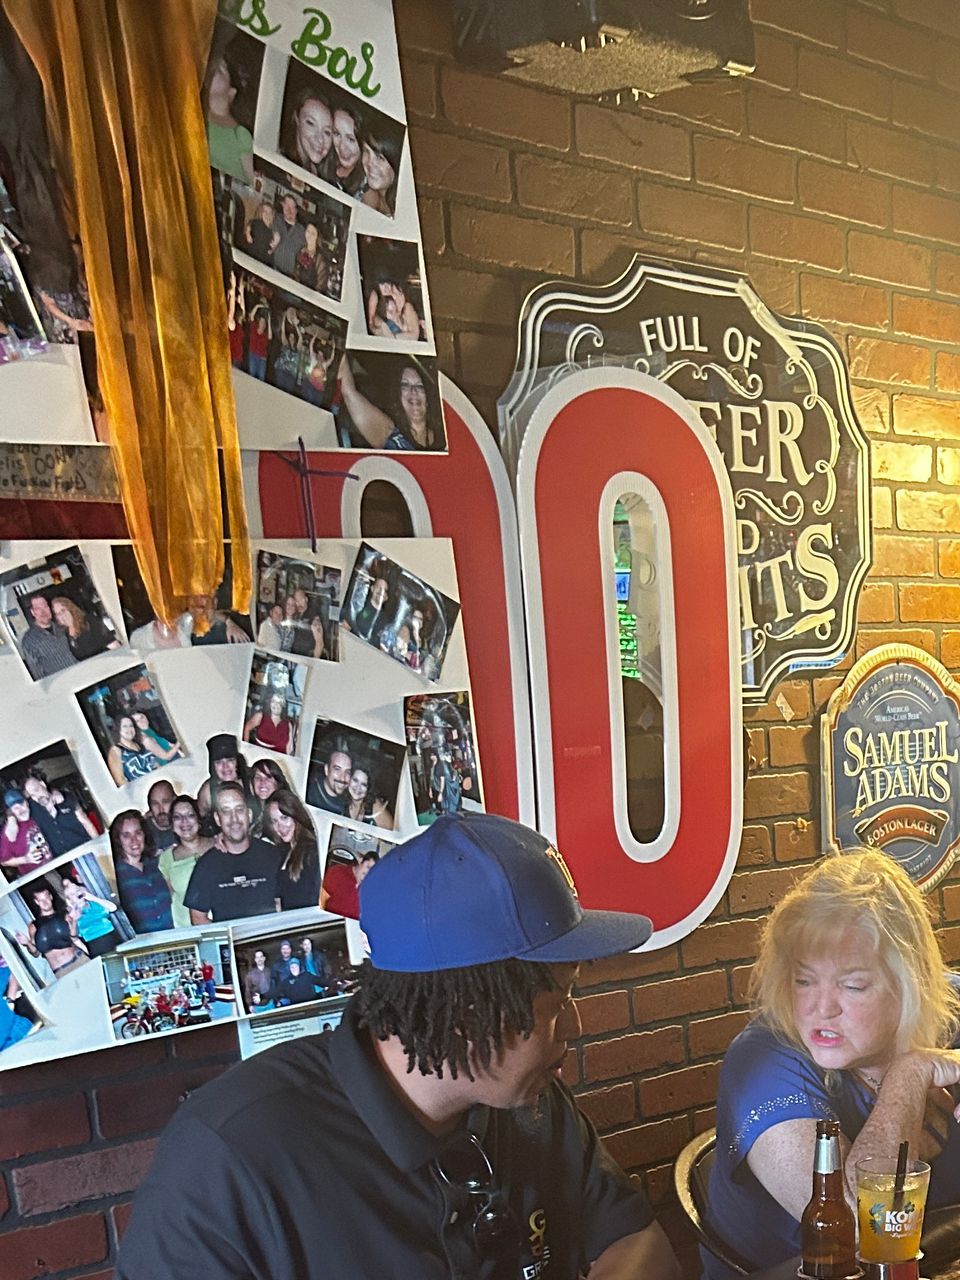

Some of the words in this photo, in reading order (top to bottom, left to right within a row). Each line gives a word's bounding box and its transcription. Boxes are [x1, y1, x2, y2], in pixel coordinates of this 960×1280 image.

[290, 7, 382, 98] Bar
[639, 315, 708, 356] FULL
[723, 326, 761, 368] OF
[687, 399, 815, 486] EER
[894, 672, 912, 683] BEER
[843, 720, 959, 778] SAMUEL
[855, 761, 951, 812] ADAMS
[867, 818, 904, 846] BOSTON
[904, 818, 937, 837] LAGER
[884, 1224, 902, 1232] BIG
